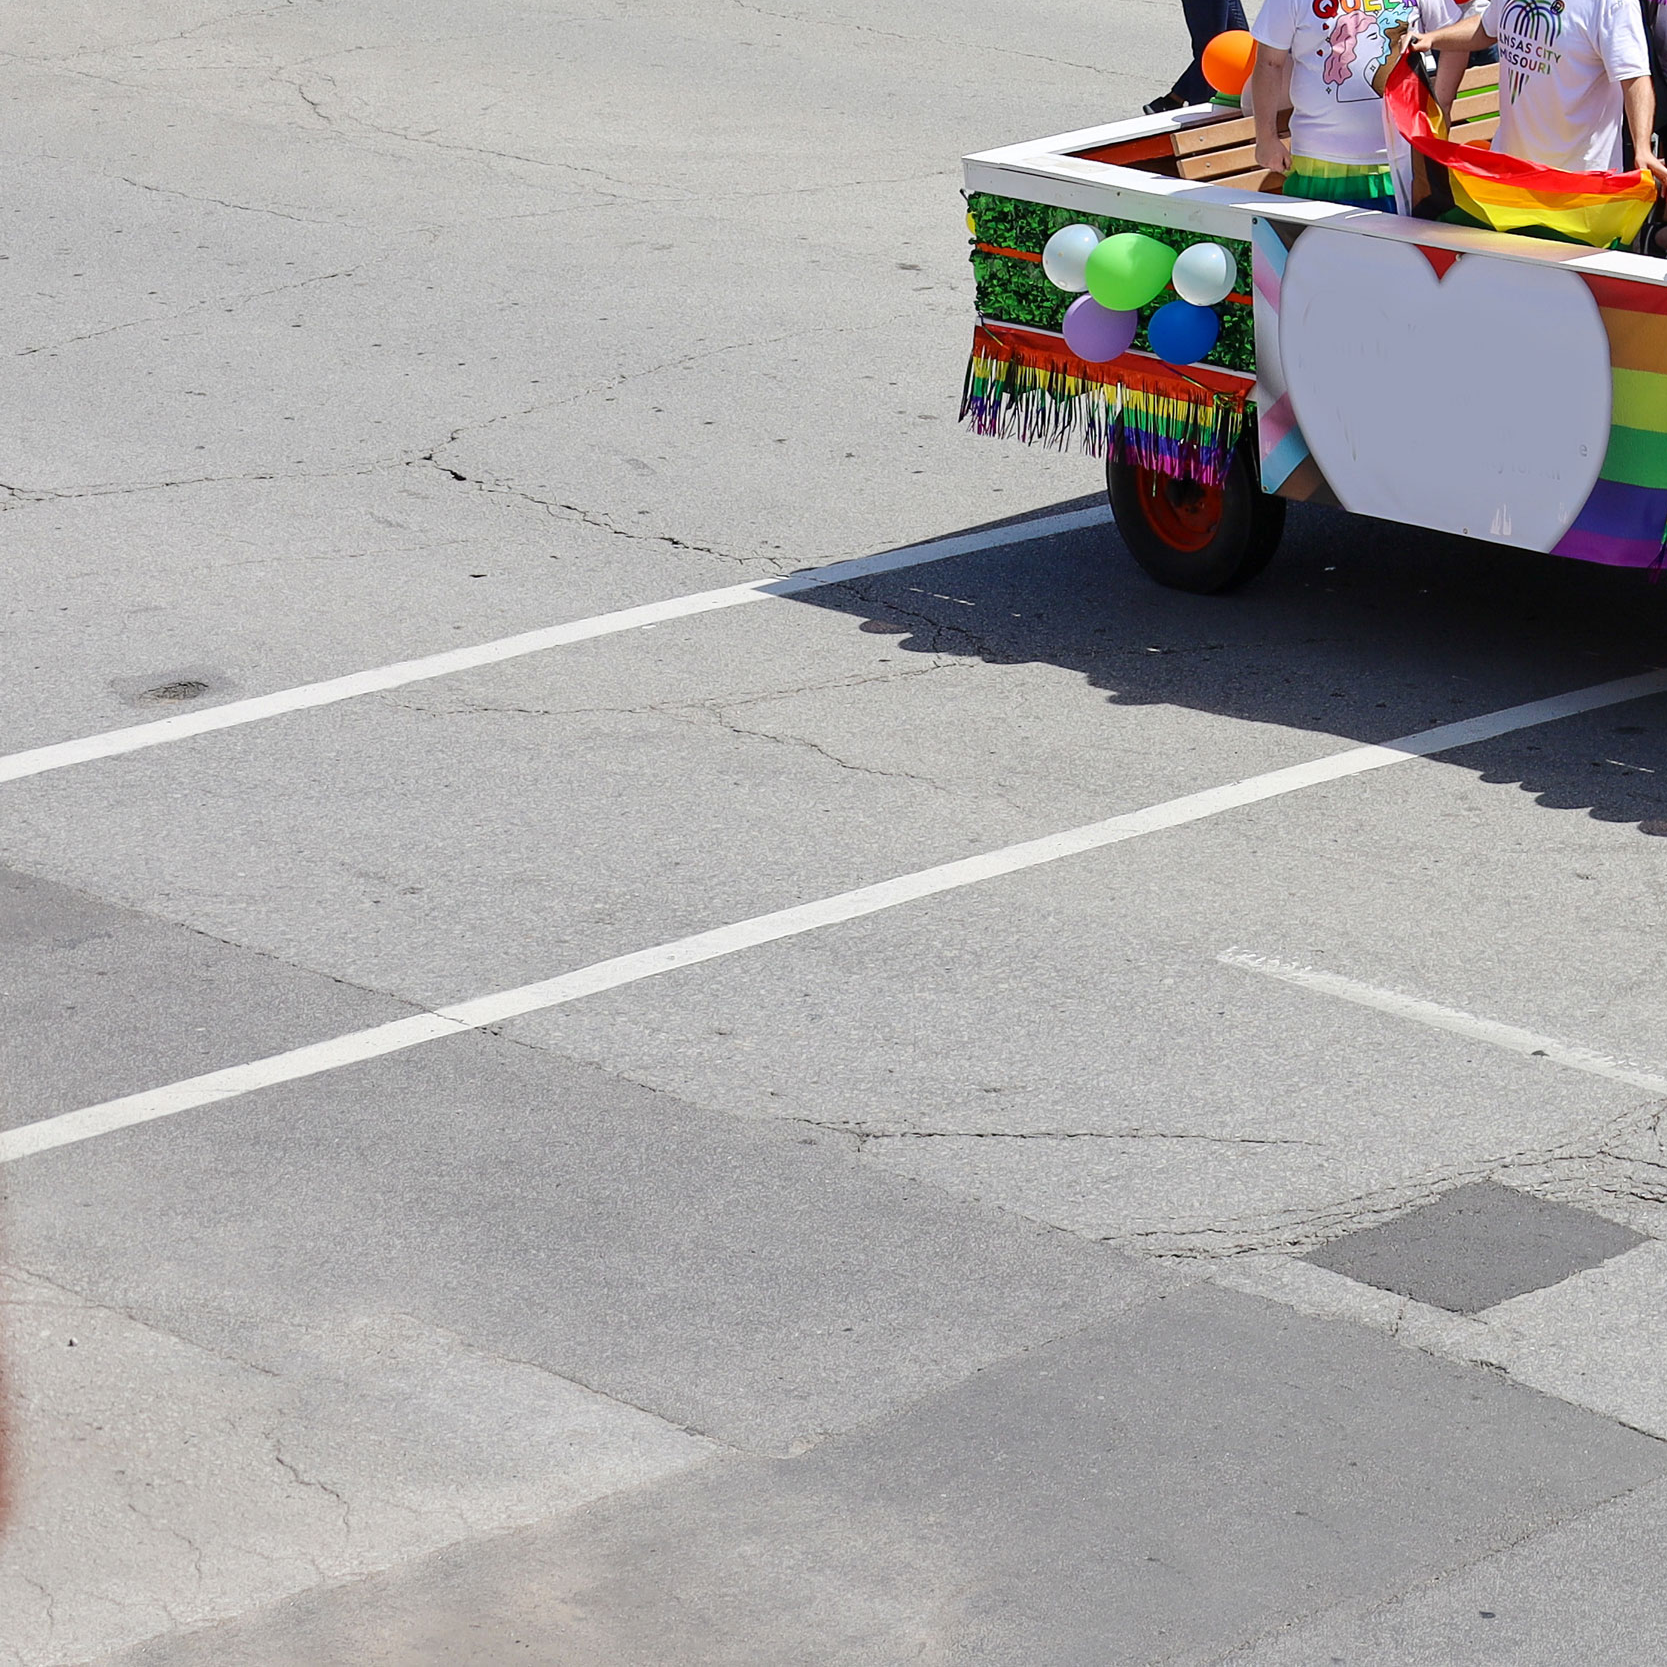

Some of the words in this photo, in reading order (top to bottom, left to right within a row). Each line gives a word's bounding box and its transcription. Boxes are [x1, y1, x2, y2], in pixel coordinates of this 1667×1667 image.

[1499, 32, 1532, 54] ANSAS
[1535, 46, 1561, 64] CITY
[1500, 47, 1550, 75] MISSOURI
